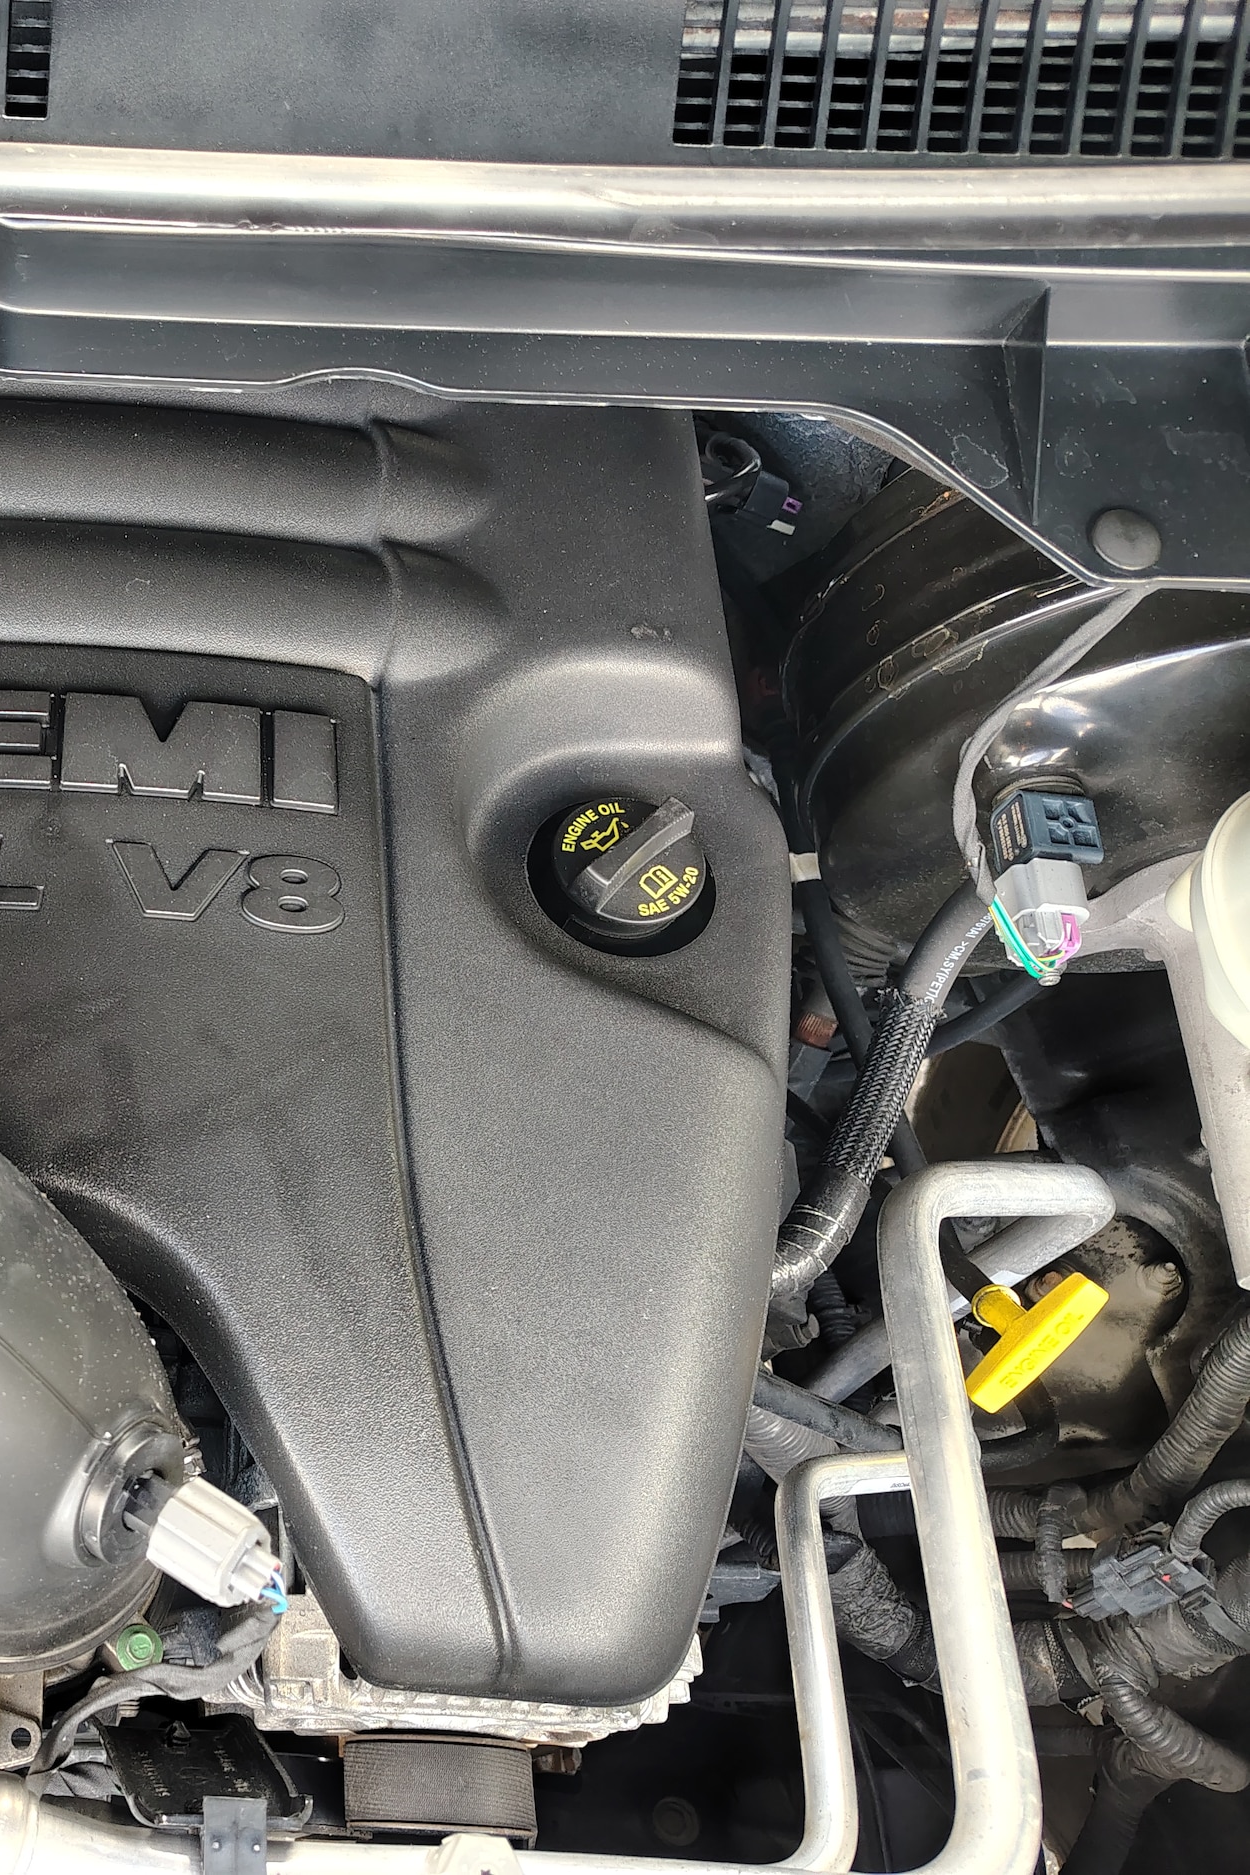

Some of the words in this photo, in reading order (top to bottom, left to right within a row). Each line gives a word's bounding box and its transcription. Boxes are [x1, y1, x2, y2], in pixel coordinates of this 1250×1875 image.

[562, 809, 599, 852] ENGINE
[598, 802, 625, 816] OIL
[105, 839, 345, 933] V8
[638, 899, 670, 917] SAE
[668, 866, 699, 905] 5W-20
[999, 1334, 1060, 1389] ENGINE
[1055, 1312, 1085, 1335] OIL
